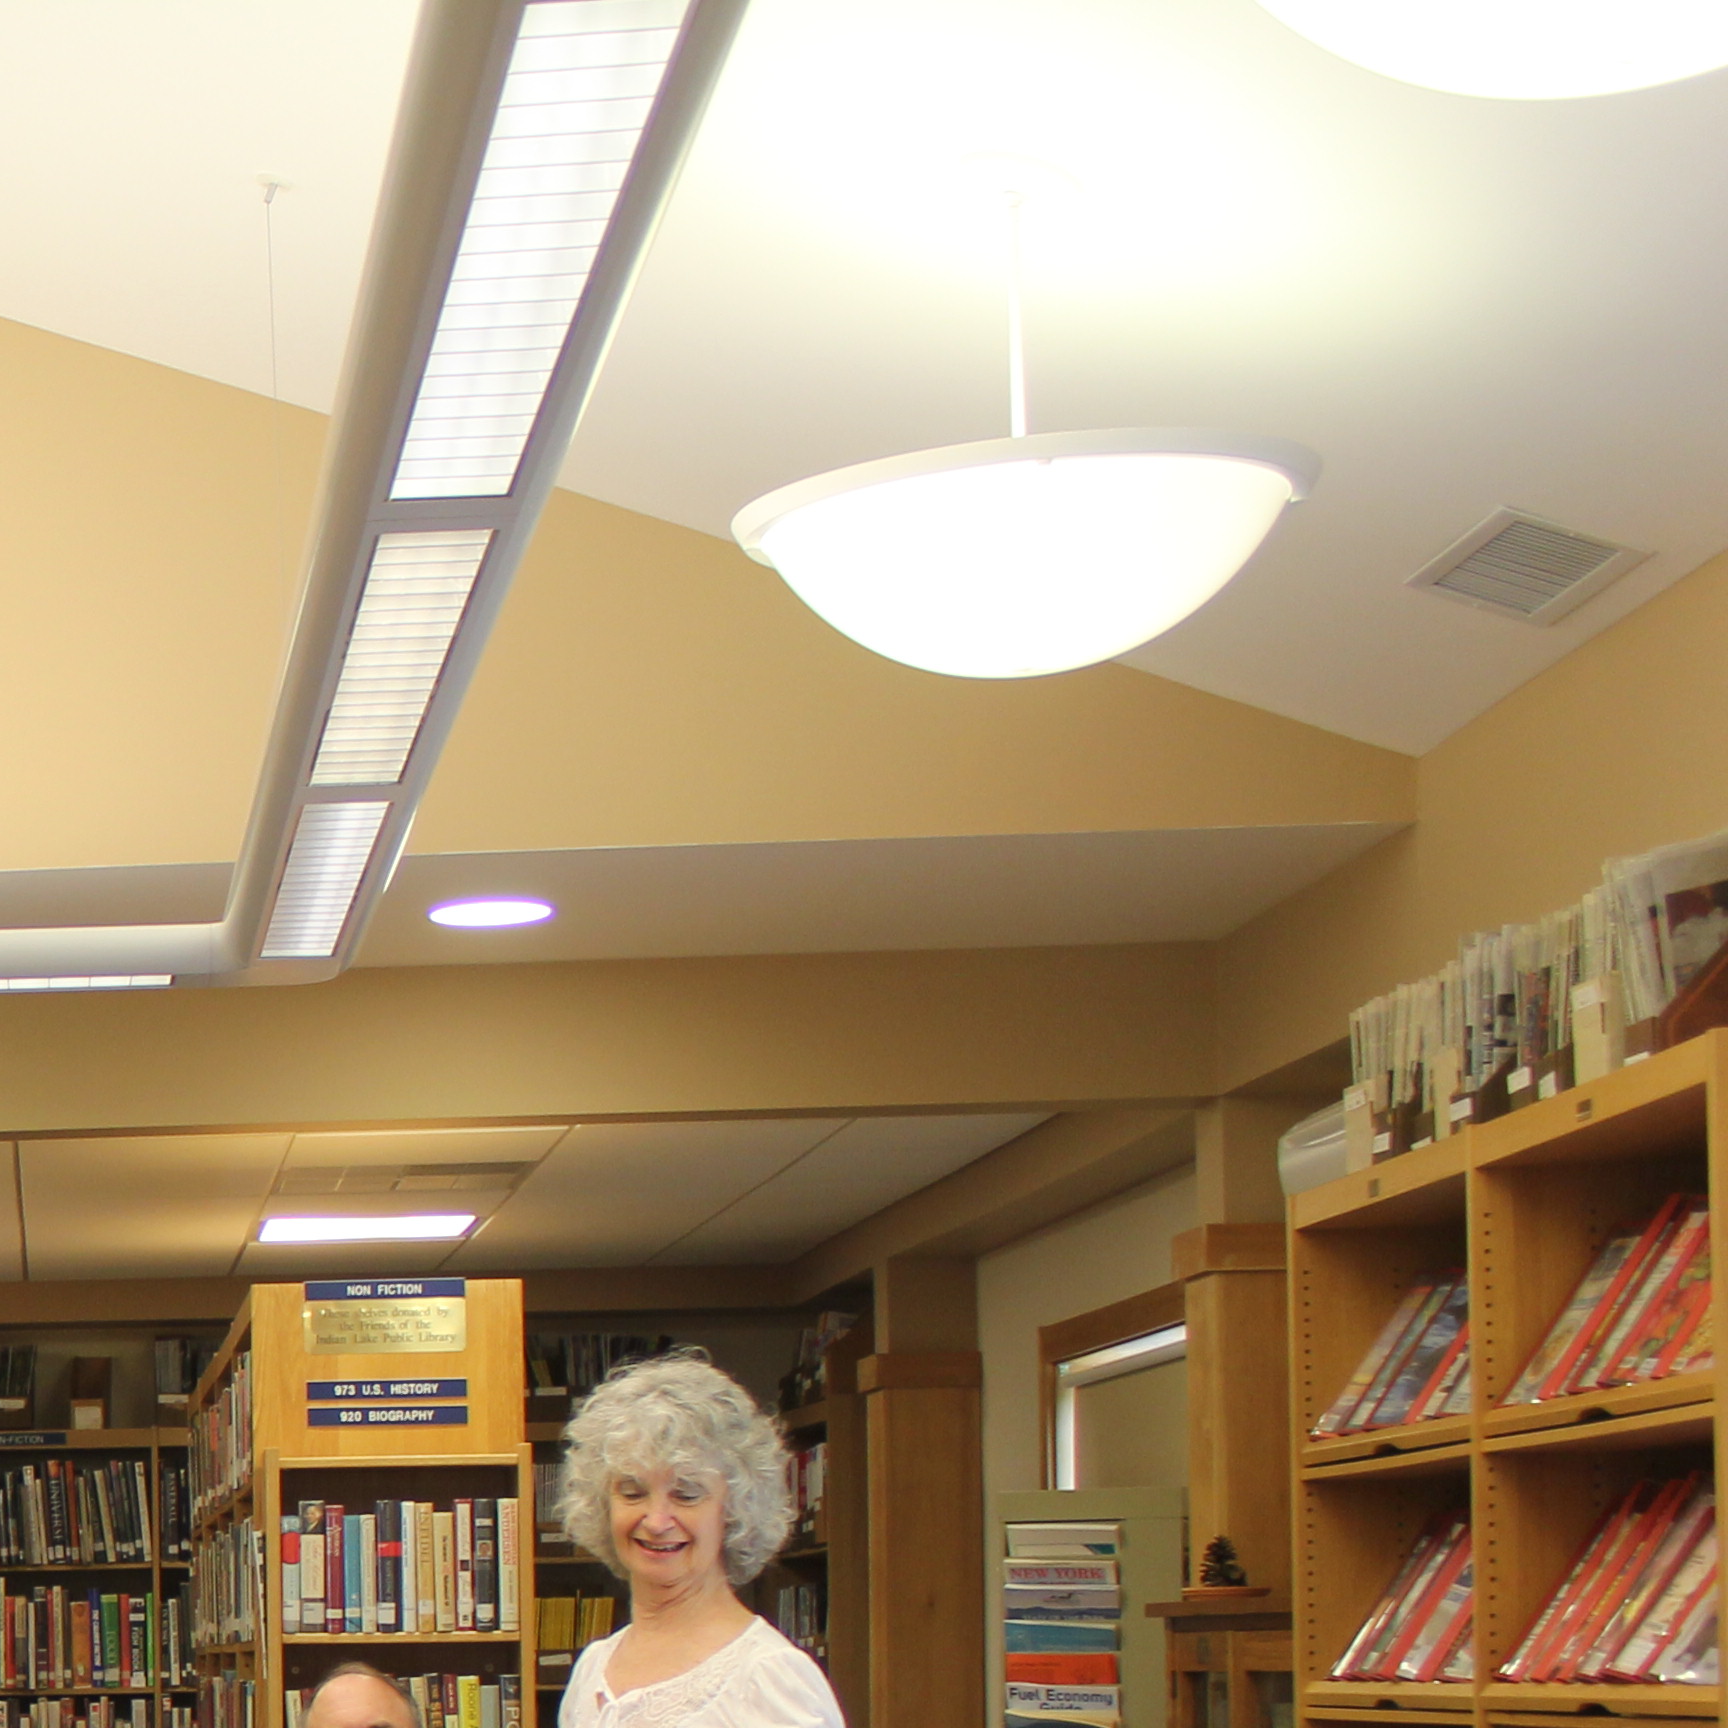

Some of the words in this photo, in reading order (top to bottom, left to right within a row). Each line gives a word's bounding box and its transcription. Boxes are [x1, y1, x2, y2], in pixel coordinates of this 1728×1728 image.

[347, 1285, 371, 1296] NON
[378, 1284, 422, 1295] FICTION
[392, 1307, 431, 1317] donated
[360, 1320, 394, 1329] Friends
[399, 1320, 409, 1329] of
[416, 1320, 431, 1329] the
[353, 1334, 378, 1343] Lake
[383, 1333, 413, 1342] Public
[419, 1332, 456, 1343] Library
[334, 1384, 355, 1395] 973
[363, 1384, 384, 1395] U.S.
[391, 1383, 439, 1394] HISTORY
[340, 1411, 361, 1422] 920
[368, 1410, 434, 1421] BIOGRAPHY
[1010, 1568, 1048, 1578] NEW
[1055, 1568, 1104, 1578] YORK
[1009, 1688, 1039, 1700] Fuel
[1047, 1689, 1113, 1705] Economy
